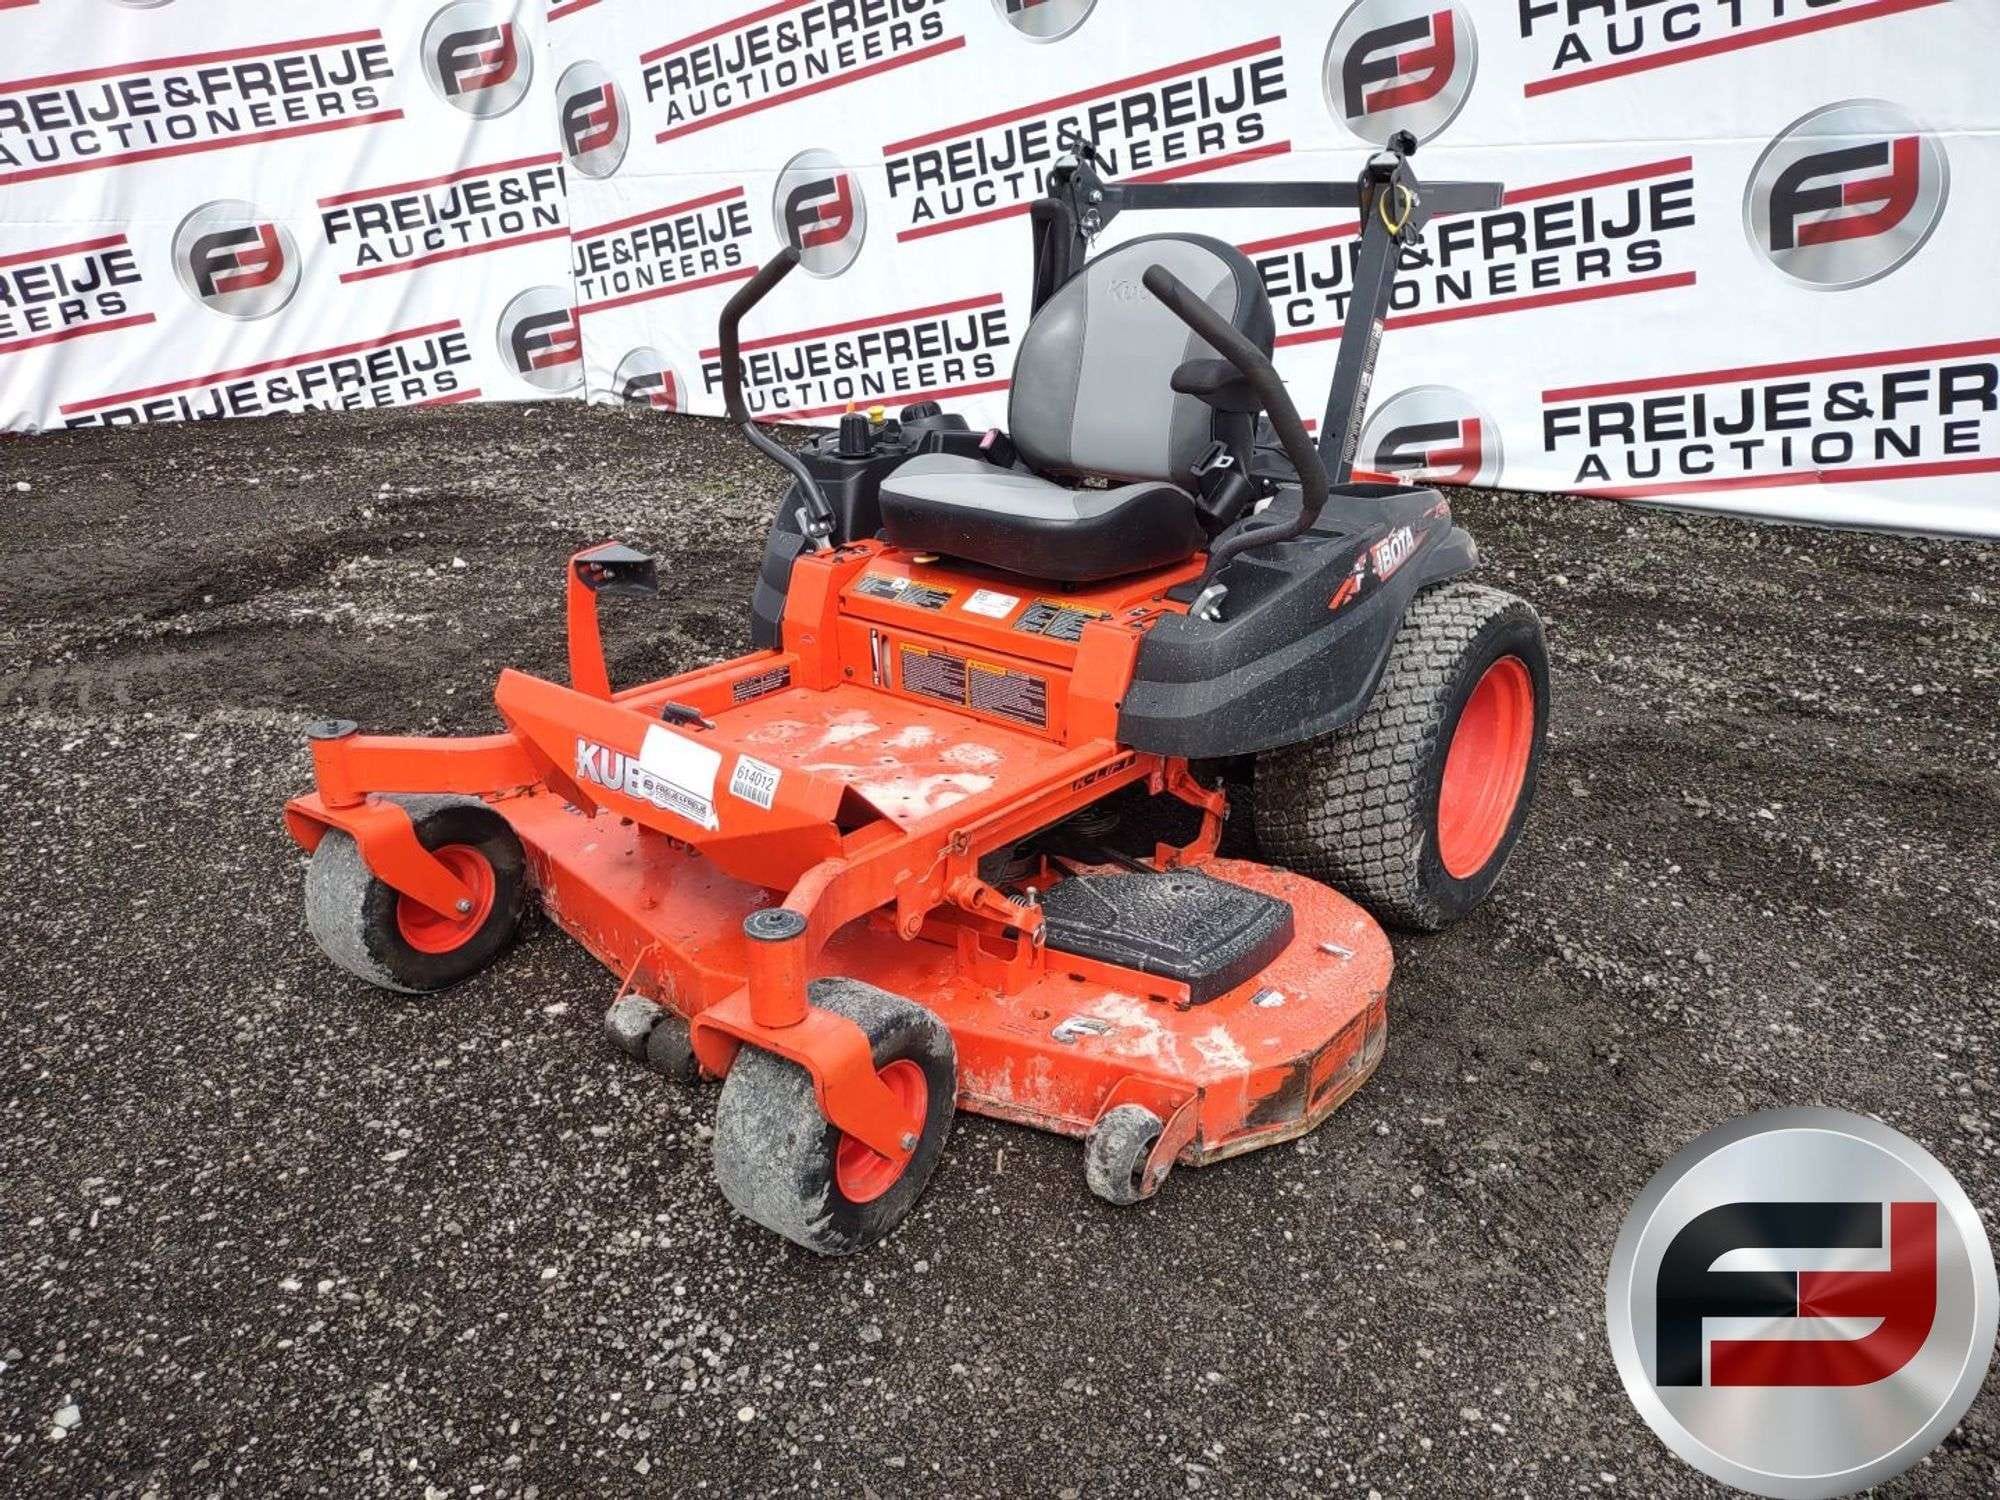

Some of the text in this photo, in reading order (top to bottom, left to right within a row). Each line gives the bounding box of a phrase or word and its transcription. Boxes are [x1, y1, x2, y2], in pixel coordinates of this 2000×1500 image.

[666, 11, 944, 126] AUCTIONEERS
[321, 166, 568, 245] FREIJE&F
[912, 112, 1265, 224] AUCTINEERS
[747, 352, 996, 413] UCTIONEERS
[736, 765, 775, 793] 614012
